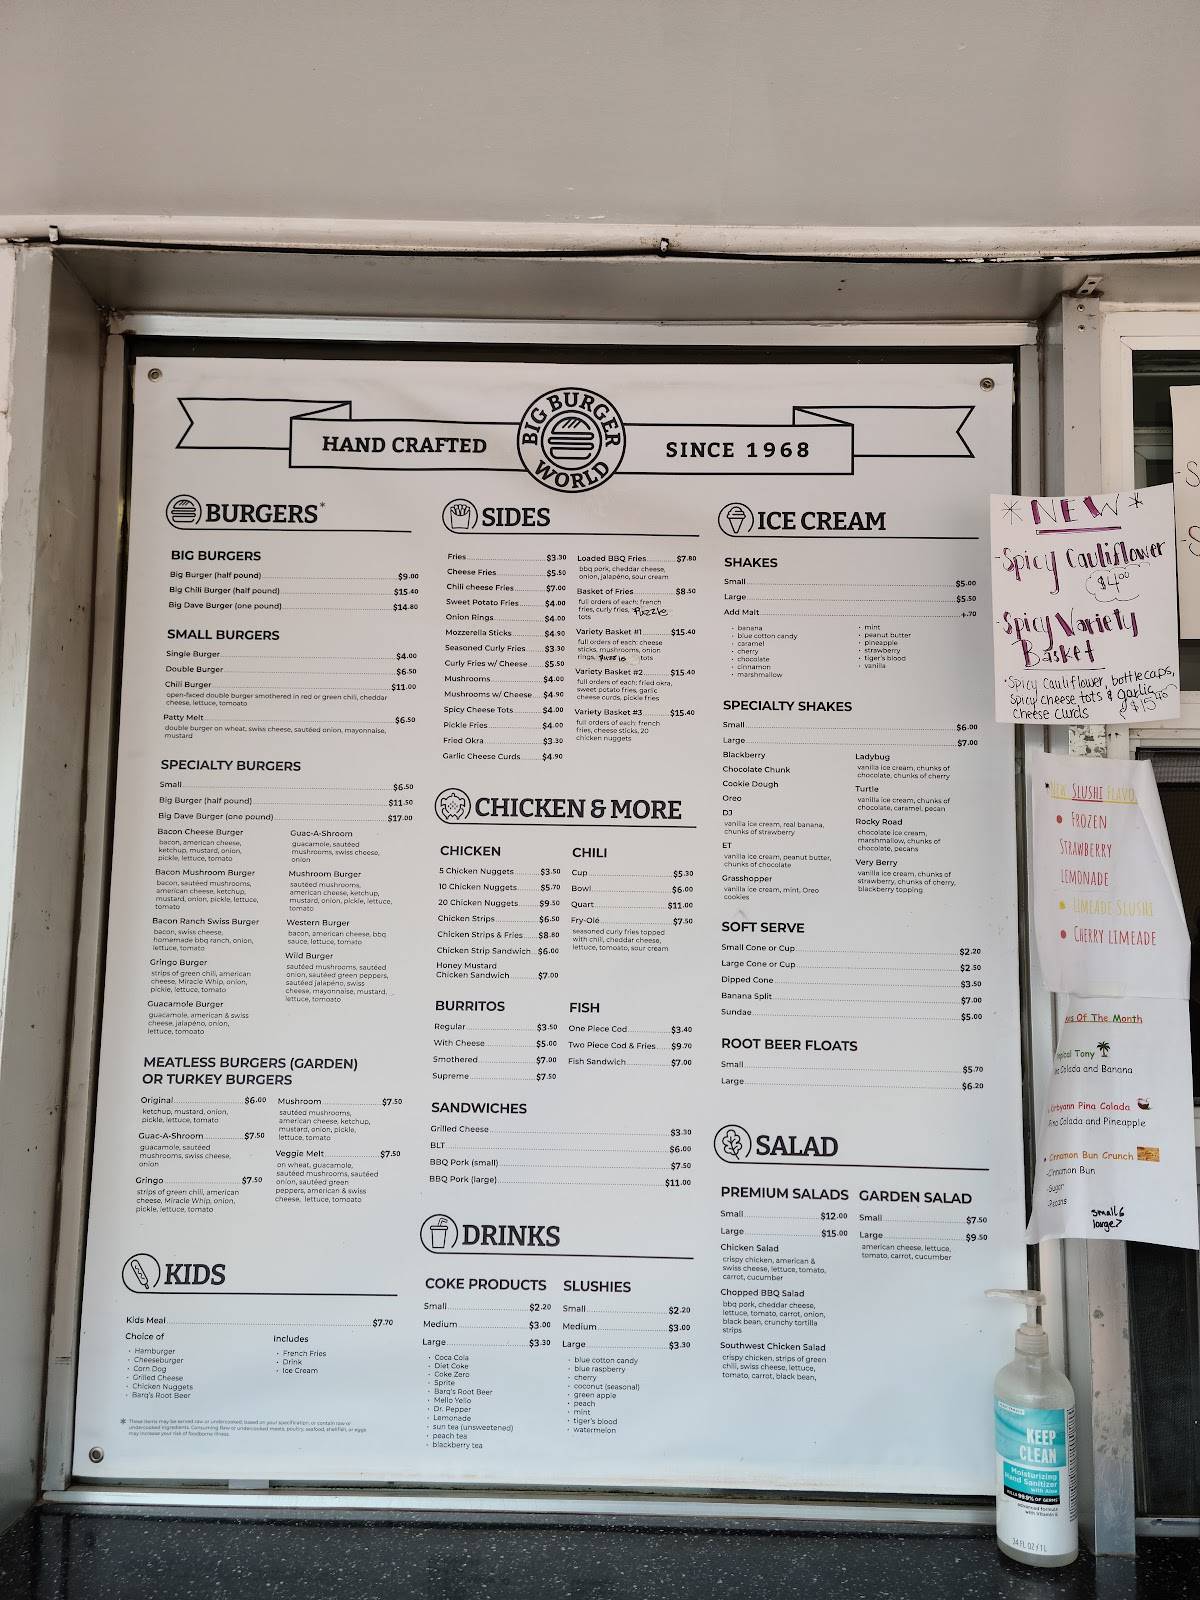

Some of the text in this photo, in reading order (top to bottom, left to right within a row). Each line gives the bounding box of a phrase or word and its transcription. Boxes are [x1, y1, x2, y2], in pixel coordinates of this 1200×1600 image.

[322, 435, 488, 454] HAND CRAFTED
[521, 391, 622, 489] BIG BURGER WORLD
[666, 441, 810, 459] SINCE 1968
[1030, 493, 1120, 525] NEW
[482, 508, 550, 526] SIDES
[758, 512, 886, 530] ICE CREAM
[172, 550, 261, 561] BIG BURGERS
[547, 554, 566, 562] $3.30
[677, 555, 696, 563] $7.80
[1066, 541, 1166, 568] Cauliflower
[725, 558, 778, 568] SHAKES
[170, 571, 183, 579] Big
[186, 572, 212, 580] Burger
[234, 572, 261, 580] pound)
[398, 573, 419, 581] $9.00
[956, 580, 976, 588] $5.00
[545, 600, 566, 608] $4.00
[168, 629, 280, 640] SMALL BURGERS
[1002, 607, 1139, 651] Spicy Variety
[166, 650, 417, 661] Single Burger $4.00
[1011, 639, 1095, 668] Basket
[1079, 691, 1103, 703] tots
[724, 700, 852, 712] SPECIALTY SHAKES
[164, 714, 184, 722] Patty
[393, 716, 416, 724] $6.50
[542, 753, 562, 761] $4.90
[161, 760, 301, 771] SPECIALTY BURGERS
[475, 797, 682, 820] CHICKEN & MORE
[440, 846, 500, 856] CHICKEN
[572, 848, 607, 858] CHILI
[671, 870, 694, 878] $5.30
[472, 915, 495, 924] Strips
[539, 915, 559, 924] $6.50
[722, 922, 804, 933] SOFT SERVE
[436, 1001, 505, 1011] BURRITOS
[570, 1002, 599, 1013] FISH
[721, 1008, 982, 1022] Sundae $5.00
[1077, 1013, 1087, 1023] Of
[1091, 1013, 1109, 1022] The
[1112, 1014, 1144, 1024] Month
[722, 1038, 858, 1051] ROOT BEER FLOATS
[1075, 1049, 1095, 1060] Tony
[144, 1057, 358, 1071] MEATLESS BURGERS (GARDEN)
[1083, 1064, 1099, 1073] and
[1101, 1064, 1133, 1074] Banana
[142, 1074, 292, 1085] OR TURKEY BURGERS
[432, 1102, 527, 1114] SANDWICHES
[1100, 1102, 1131, 1111] Colada
[1085, 1117, 1101, 1125] and
[1103, 1117, 1146, 1129] Pineapple
[671, 1129, 692, 1137] $3.30
[756, 1135, 838, 1157] SALAD
[1082, 1151, 1099, 1159] Bun
[1102, 1151, 1134, 1160] Crunch
[1079, 1166, 1096, 1175] Bun
[722, 1186, 849, 1200] PREMIUM SALADS
[859, 1190, 972, 1204] GARDEN SALAD
[462, 1224, 560, 1247] DRINKS
[721, 1228, 848, 1238] Large $15.00
[164, 1264, 226, 1285] KIDS
[426, 1278, 546, 1290] COKE PRODUCTS
[564, 1280, 631, 1292] SLUSHIES
[126, 1316, 144, 1324] Kids
[370, 1318, 393, 1328] $7.70
[424, 1320, 550, 1330] Medium $3.00
[767, 1342, 800, 1350] Chicken
[135, 1348, 175, 1356] Hamburger
[1026, 1427, 1056, 1446] KEEP
[1019, 1445, 1057, 1464] CLEAN
